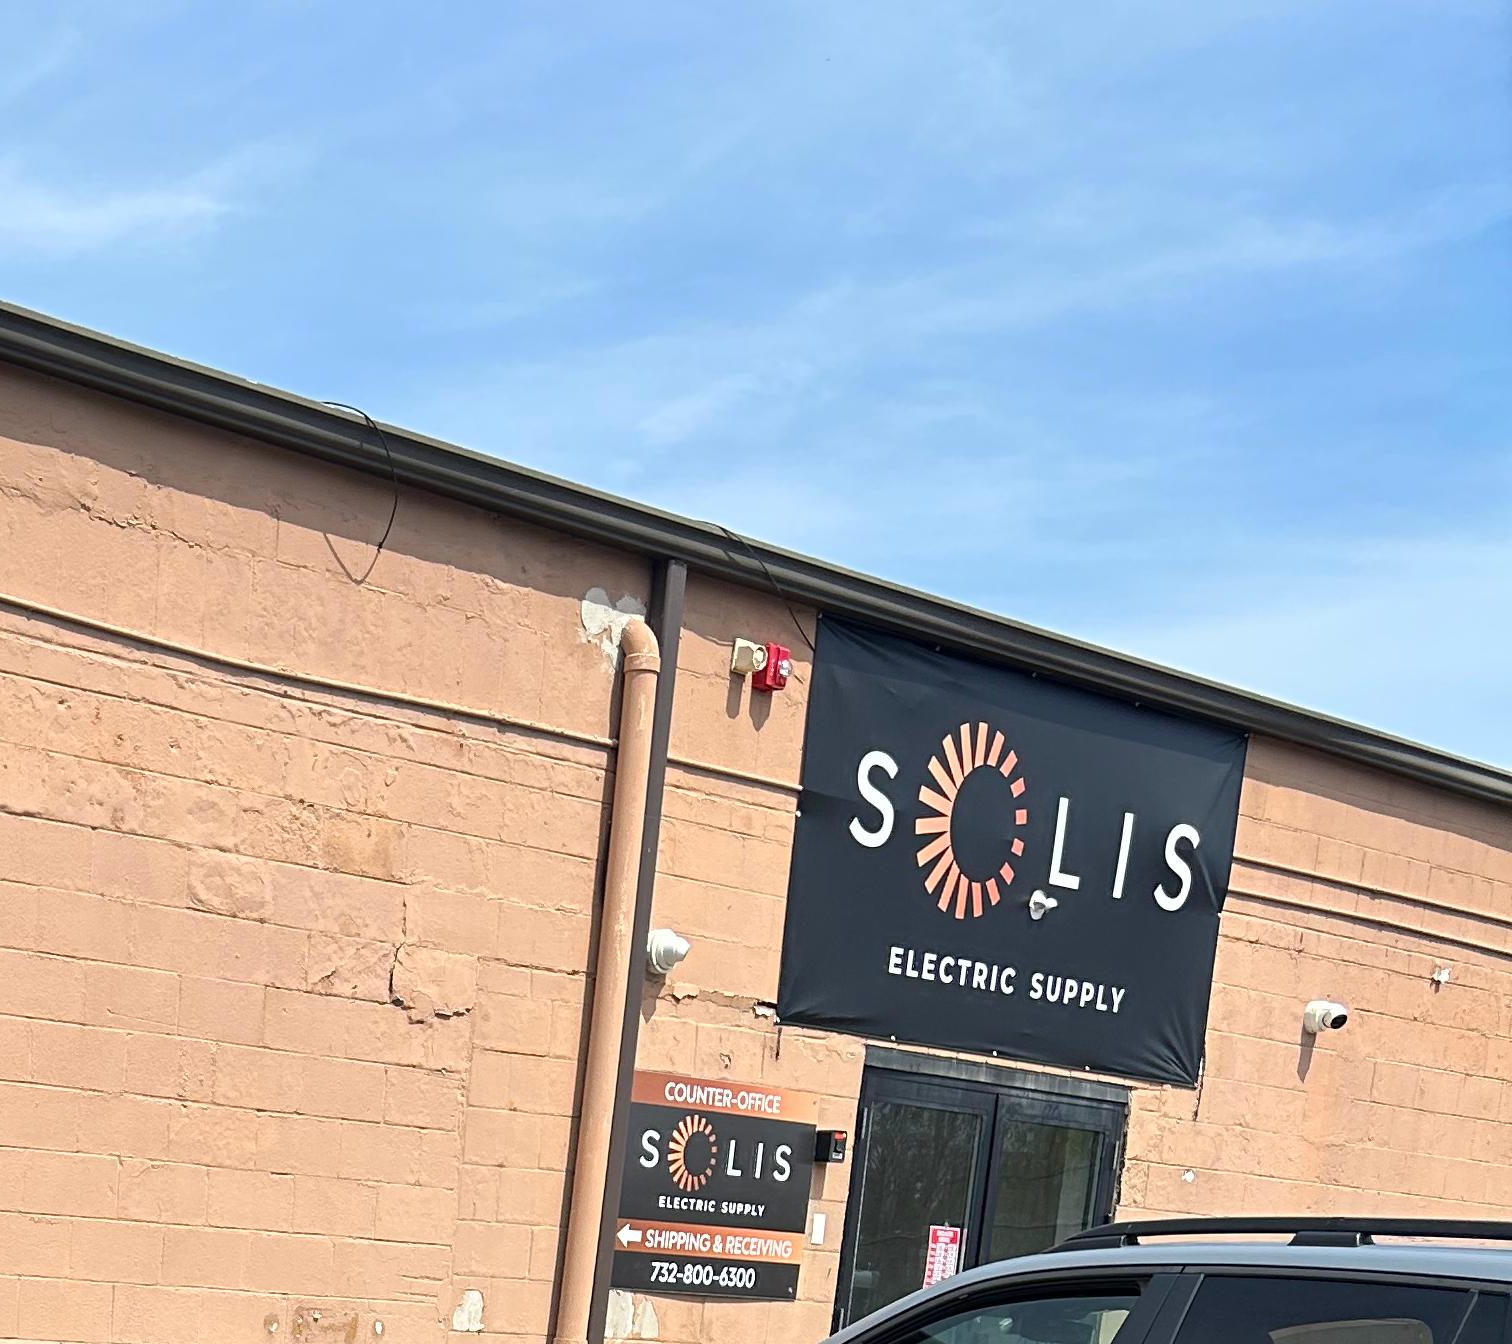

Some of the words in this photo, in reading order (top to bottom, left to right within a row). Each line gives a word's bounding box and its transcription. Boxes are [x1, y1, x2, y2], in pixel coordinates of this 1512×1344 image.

[849, 722, 1201, 919] SOLIS
[888, 946, 1017, 995] ELECTRIC
[1029, 972, 1126, 1014] SUPPLY
[664, 1081, 781, 1114] COUNTER-OFFICE
[639, 1114, 792, 1192] SOLIS
[658, 1195, 716, 1213] ELECTRIC
[721, 1201, 765, 1218] SUPPLY
[645, 1229, 710, 1252] SHIPPING
[712, 1235, 723, 1252] &
[725, 1236, 793, 1257] RECEIVING
[650, 1261, 756, 1289] 732-800-6300
